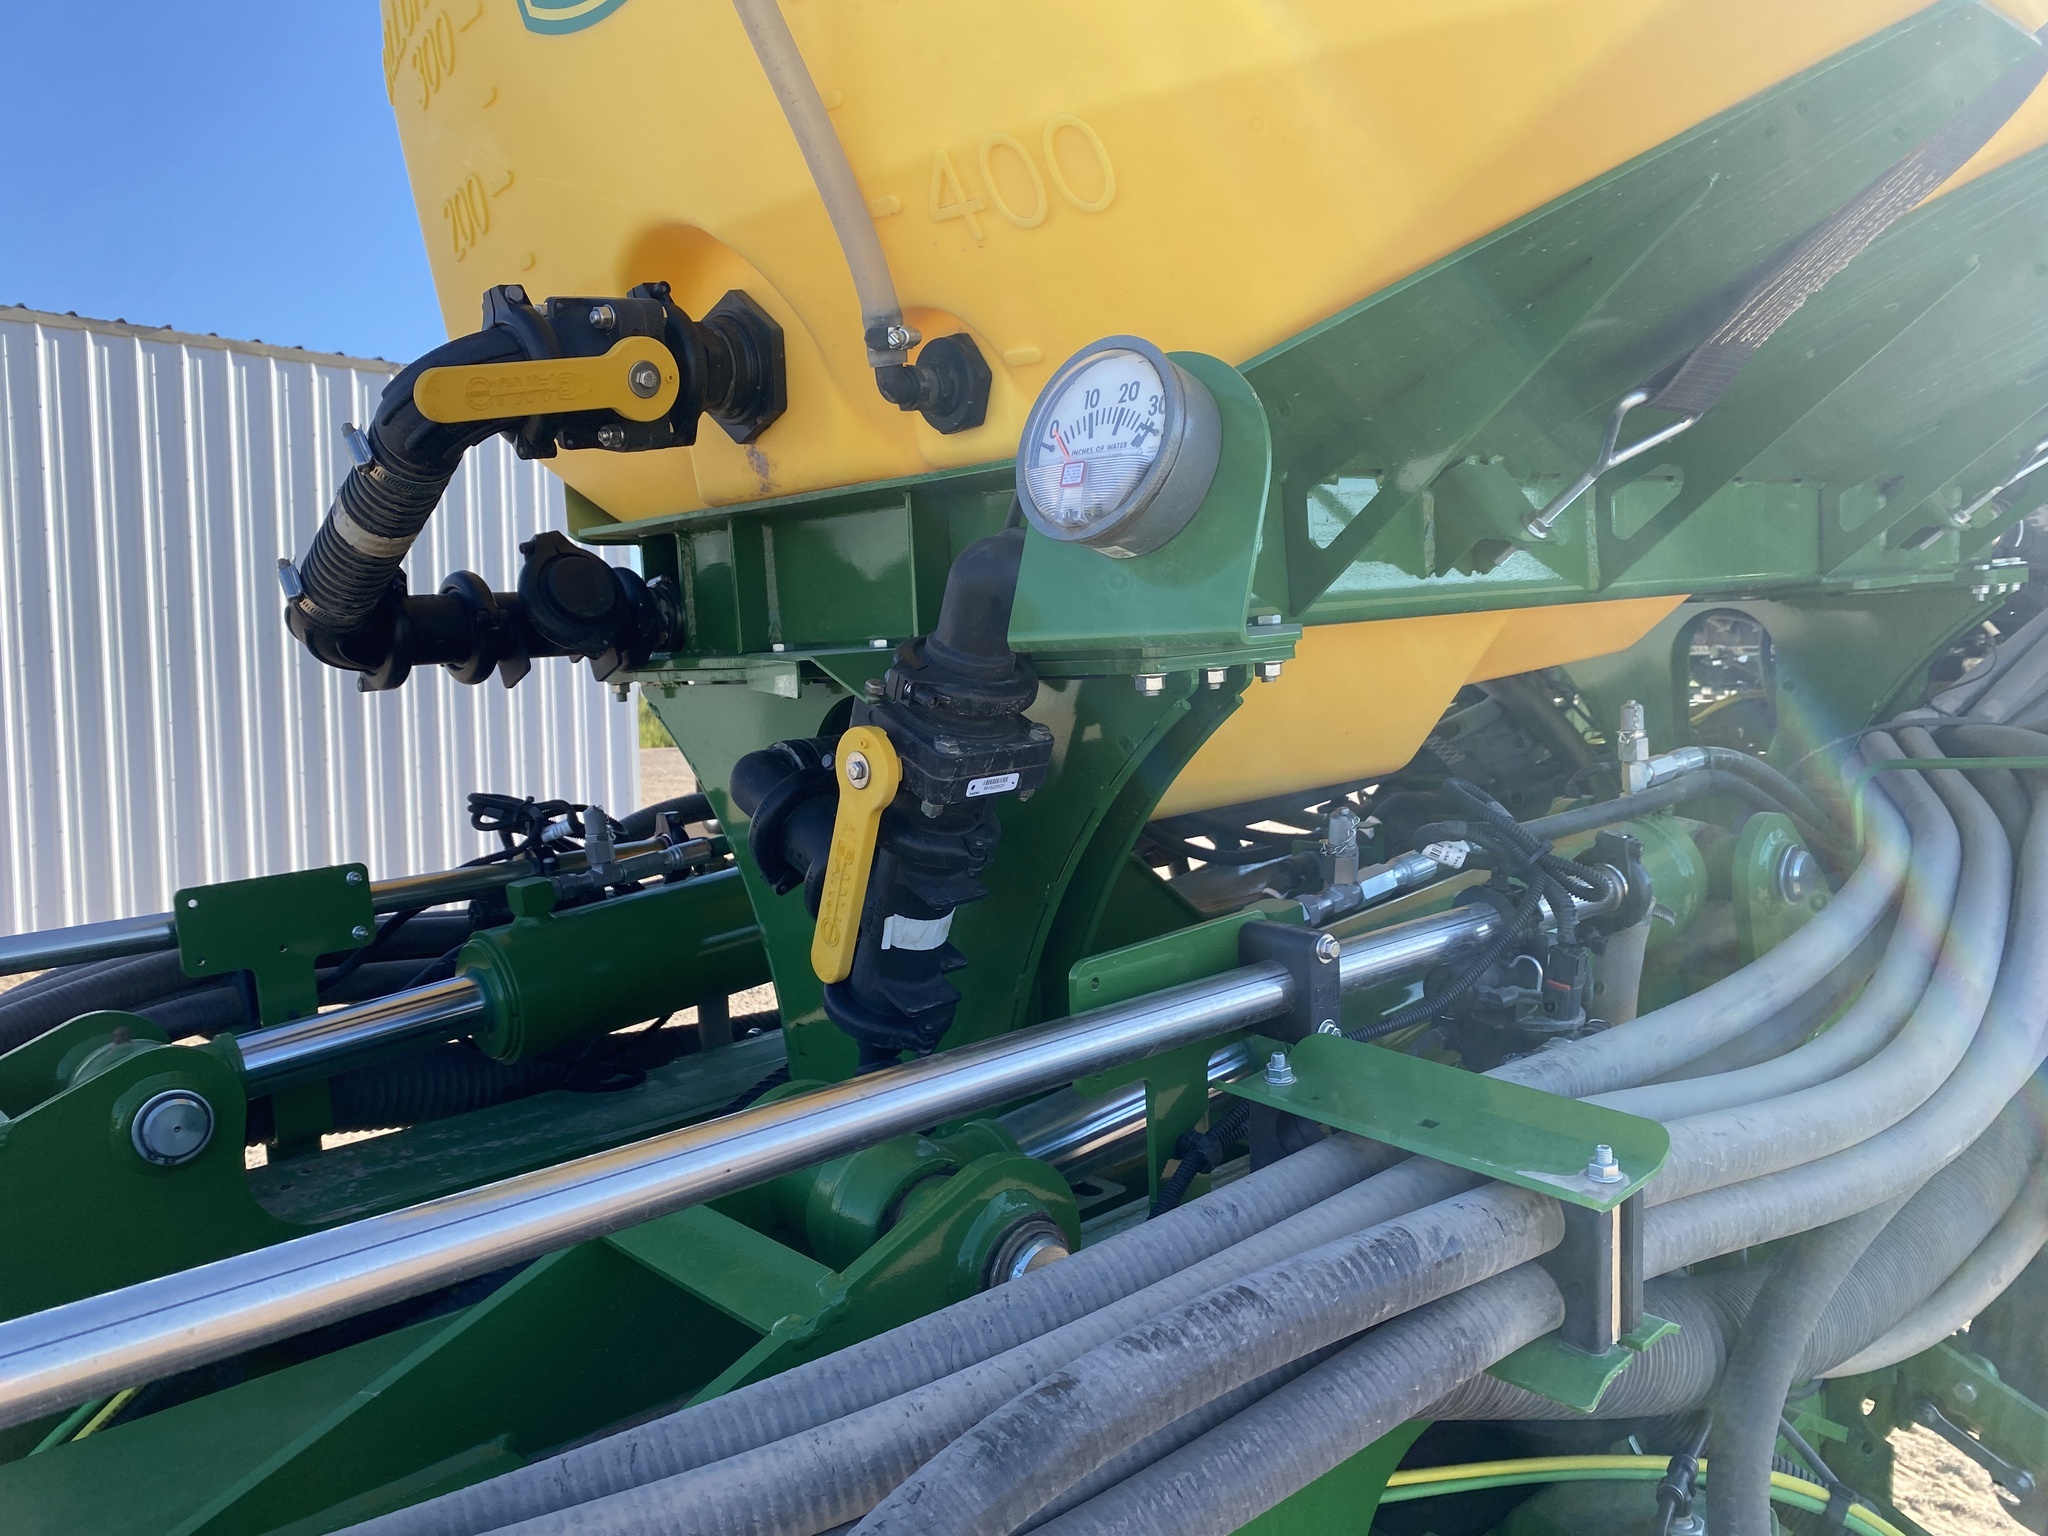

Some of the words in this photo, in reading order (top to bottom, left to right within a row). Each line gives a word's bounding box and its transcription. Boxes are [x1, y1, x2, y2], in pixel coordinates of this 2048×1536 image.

[412, 10, 455, 110] 300
[929, 113, 1116, 241] 400
[443, 171, 490, 262] 200
[1084, 388, 1100, 409] 10
[1118, 381, 1140, 404] 20
[1049, 419, 1059, 439] 0
[1071, 447, 1094, 455] INCHES
[1096, 445, 1105, 453] OF
[1107, 441, 1128, 450] WATER
